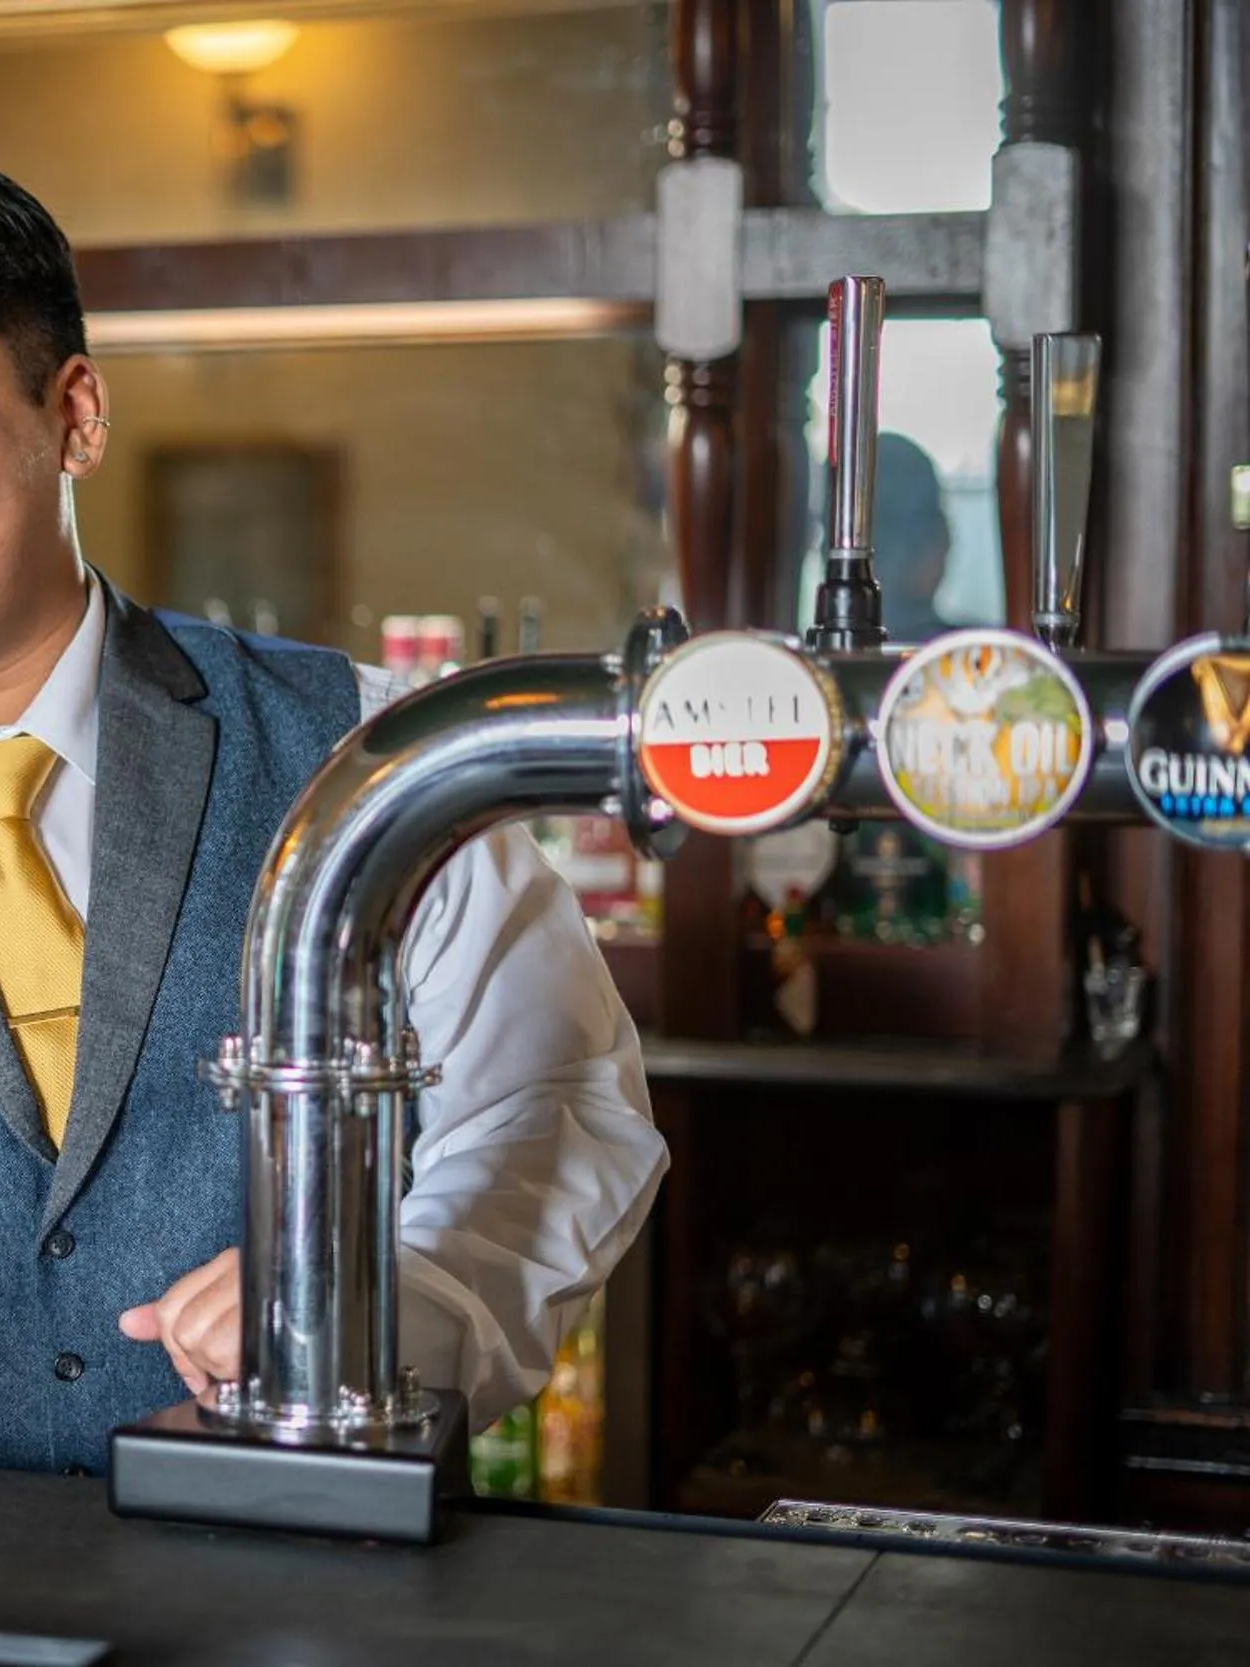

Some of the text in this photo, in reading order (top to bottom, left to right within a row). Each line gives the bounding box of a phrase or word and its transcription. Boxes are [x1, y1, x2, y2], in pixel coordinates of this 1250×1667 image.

[652, 694, 802, 731] AMTEL
[688, 740, 770, 778] BIER
[1009, 719, 1069, 775] OIL
